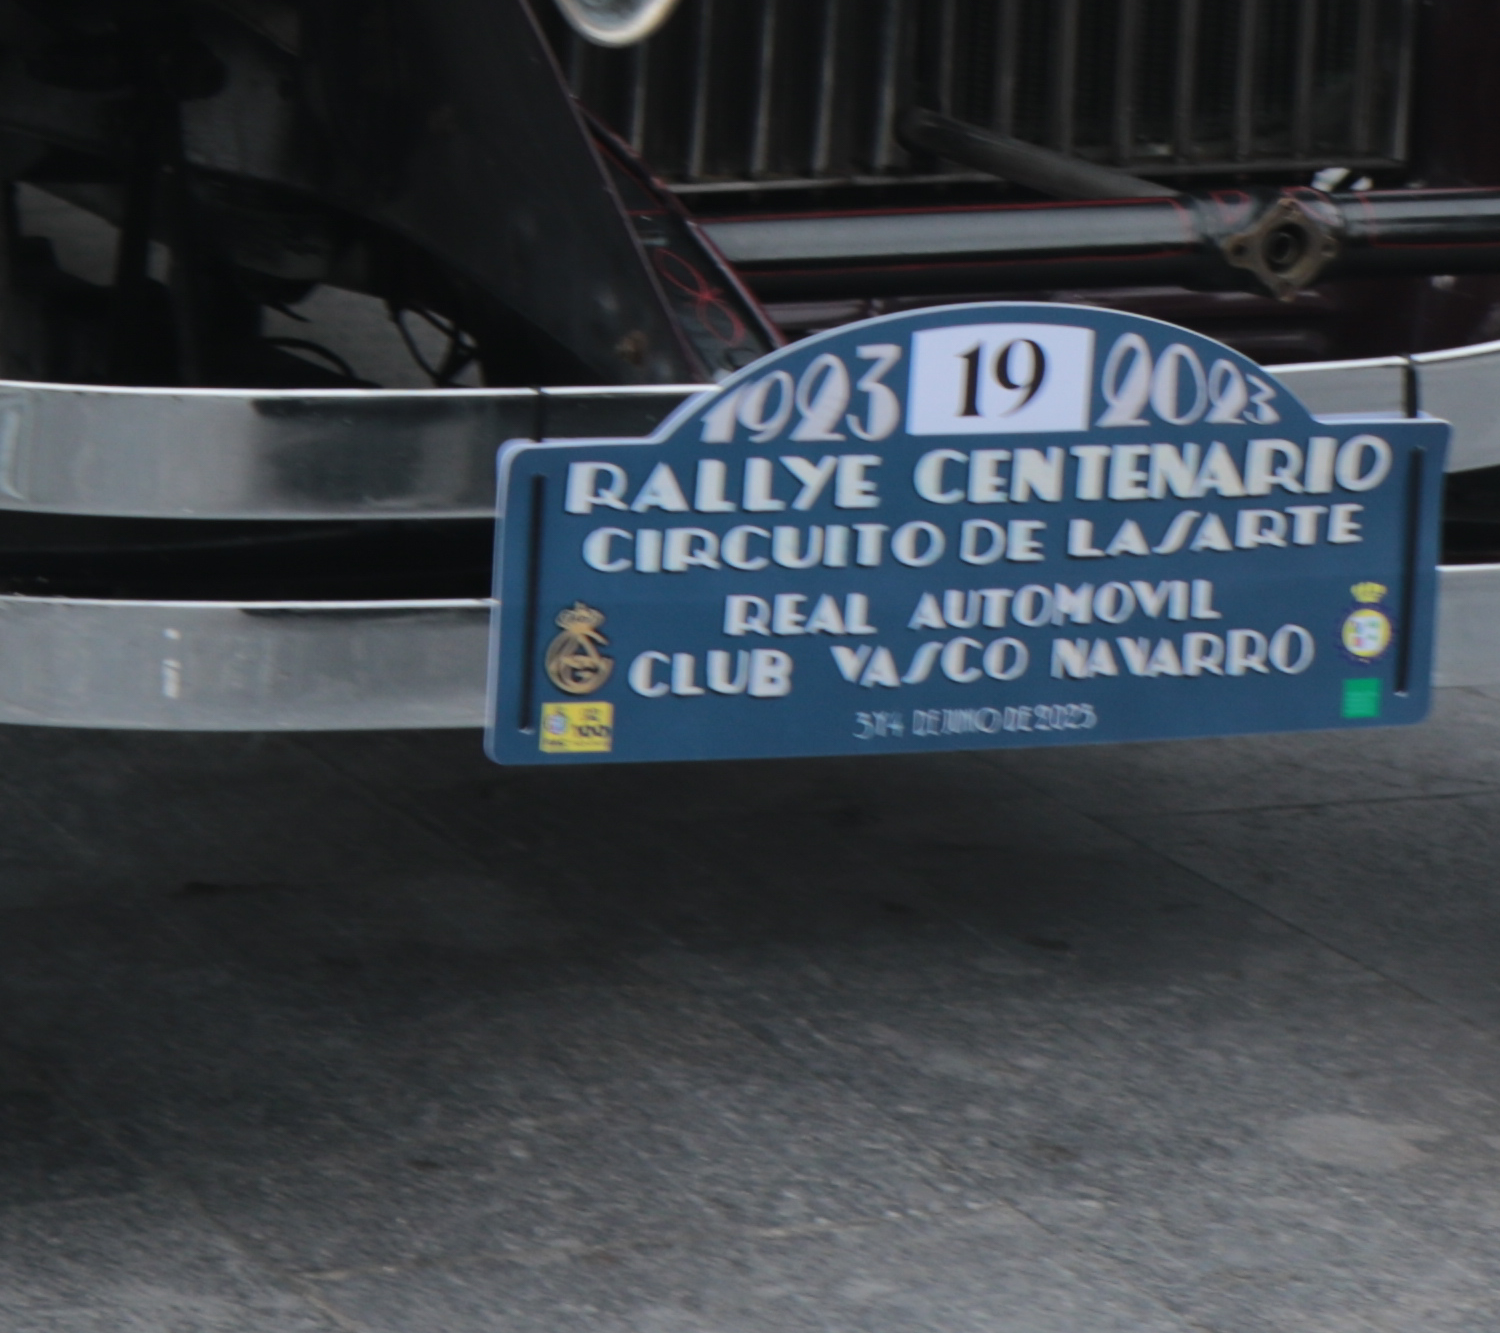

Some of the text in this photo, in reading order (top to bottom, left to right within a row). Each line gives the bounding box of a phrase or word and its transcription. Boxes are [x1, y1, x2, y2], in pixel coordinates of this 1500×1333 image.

[699, 332, 1282, 444] 1923 19 2023
[564, 434, 1394, 515] RALLYE CENTENARIO
[582, 503, 1365, 573] CIRCUITO DE LASARTE
[723, 578, 1222, 636] REAL AUTOMOVIL
[627, 623, 1315, 698] CLUB VASCO NAVARRO
